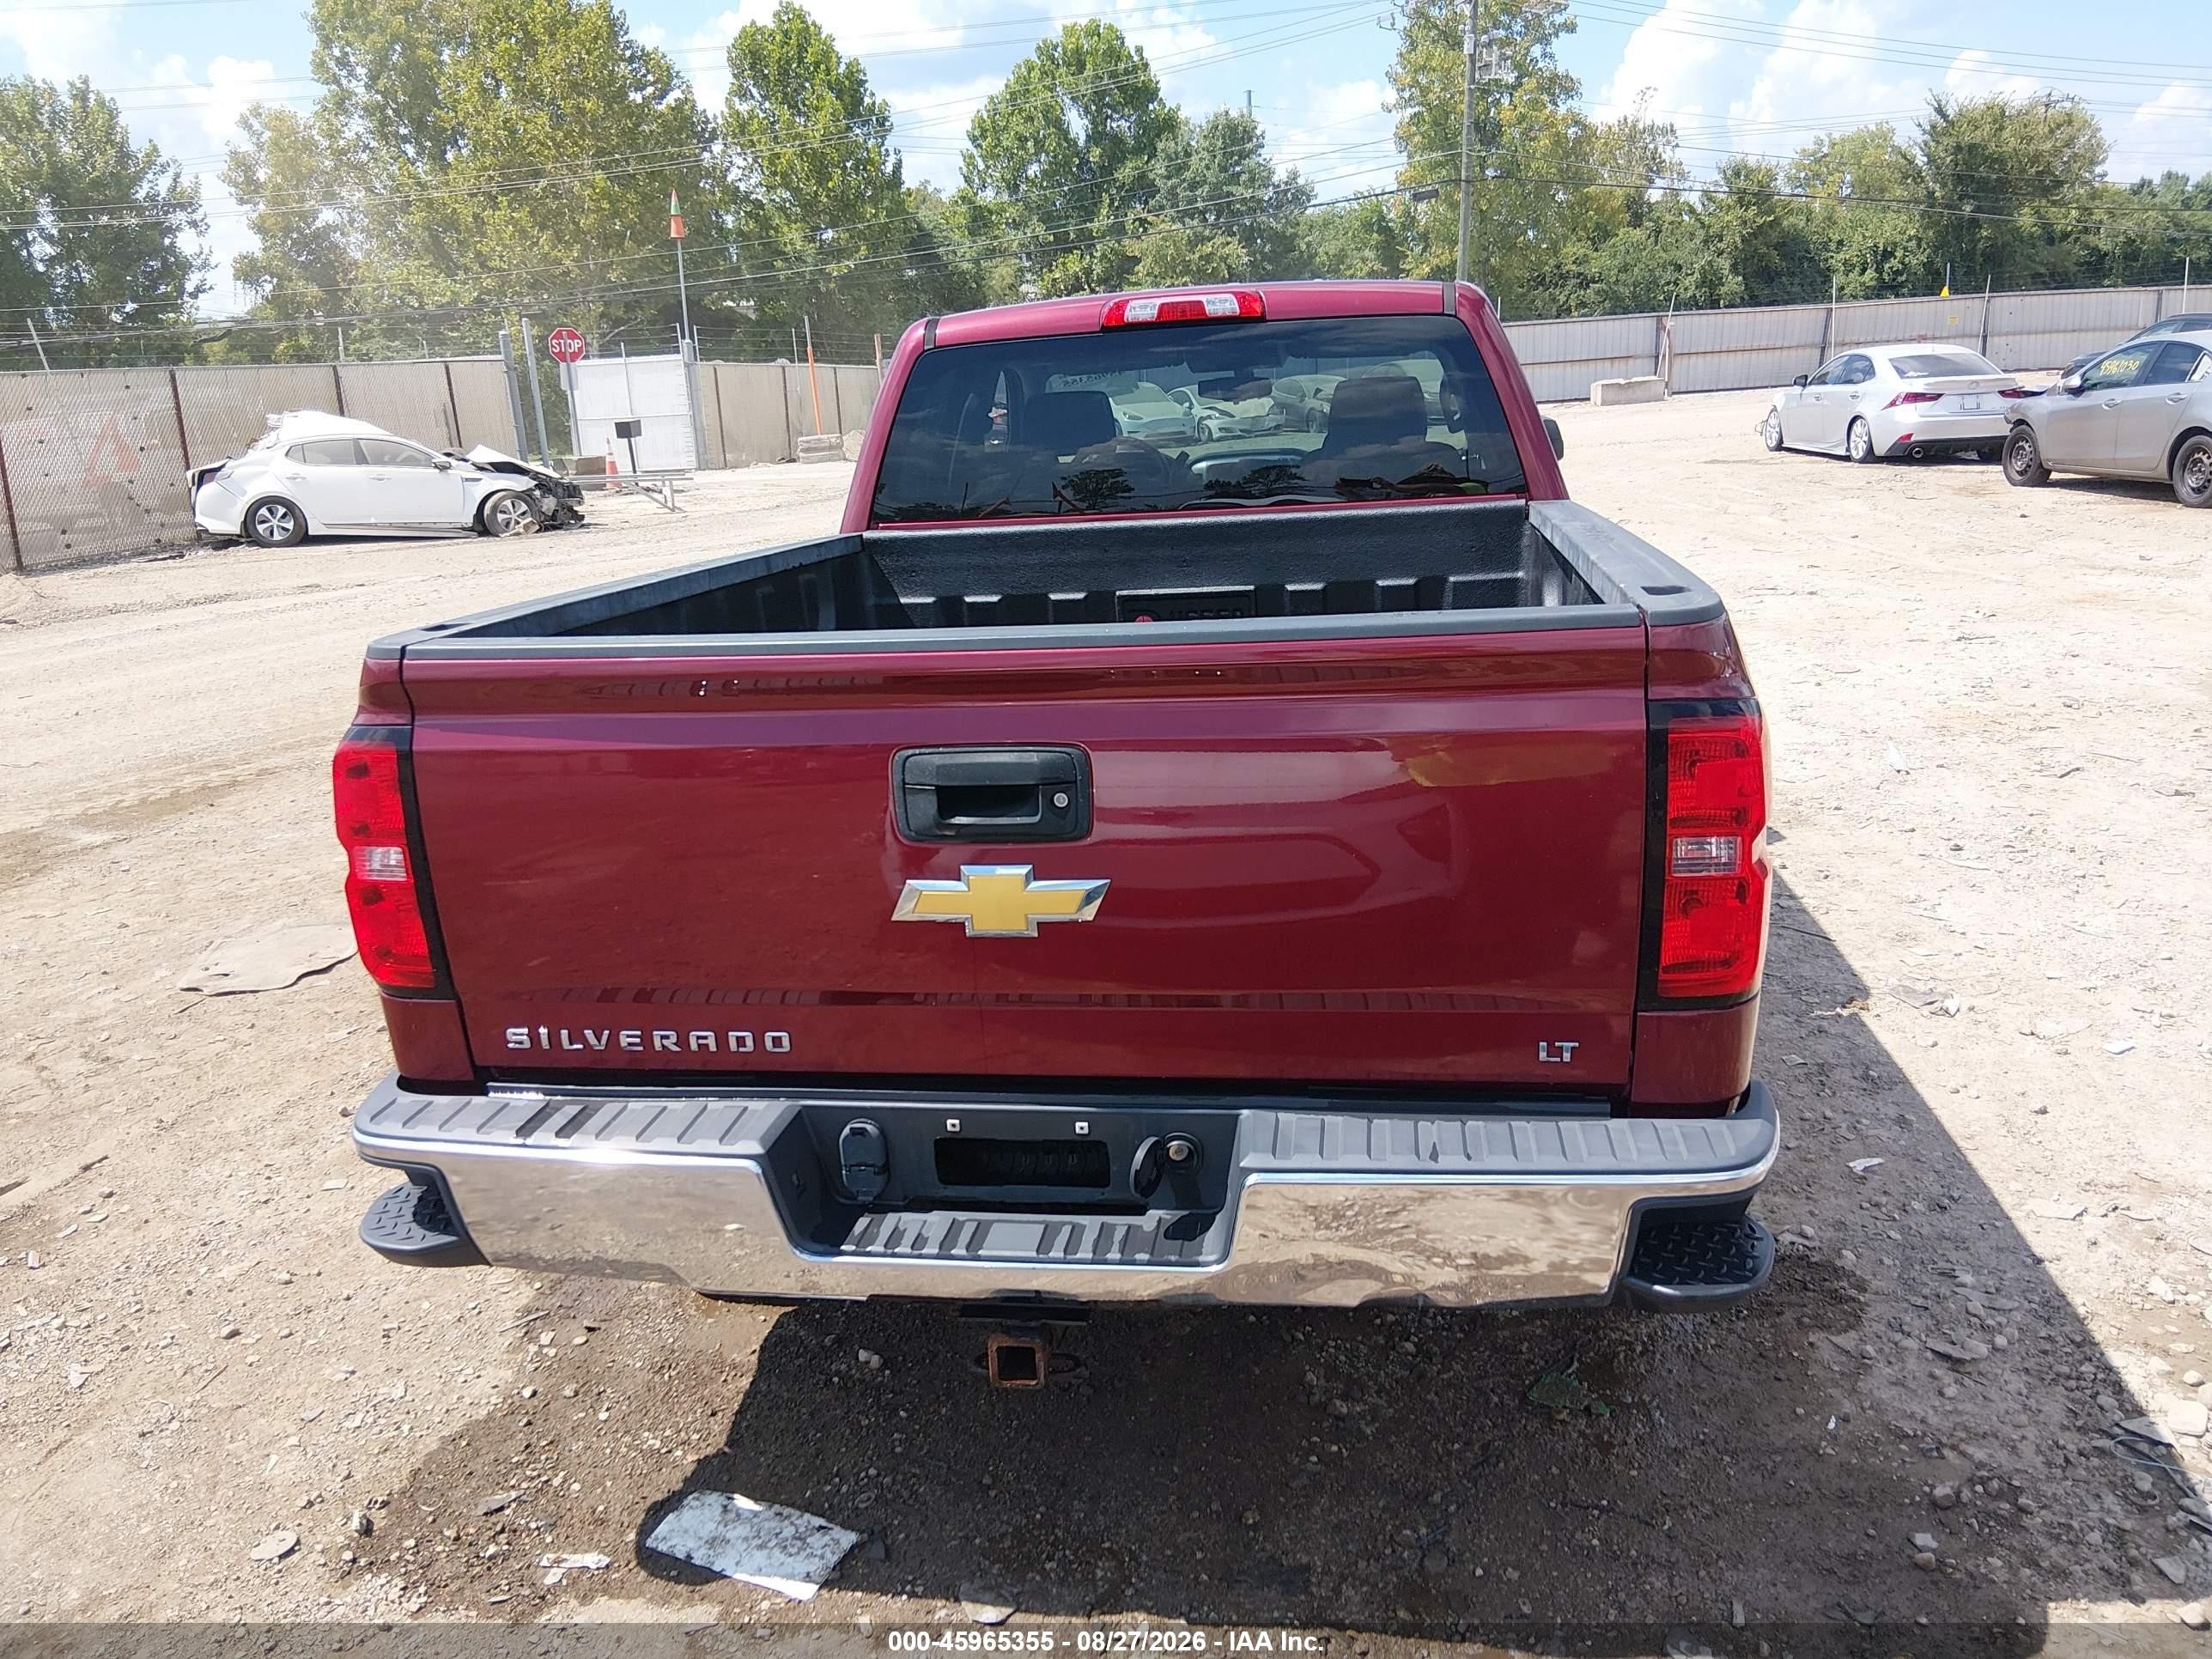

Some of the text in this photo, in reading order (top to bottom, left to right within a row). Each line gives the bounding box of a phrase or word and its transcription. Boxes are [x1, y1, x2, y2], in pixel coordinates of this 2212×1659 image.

[551, 339, 582, 353] STOP
[505, 1025, 793, 1053] SILVERADO
[1538, 1041, 1580, 1062] LT
